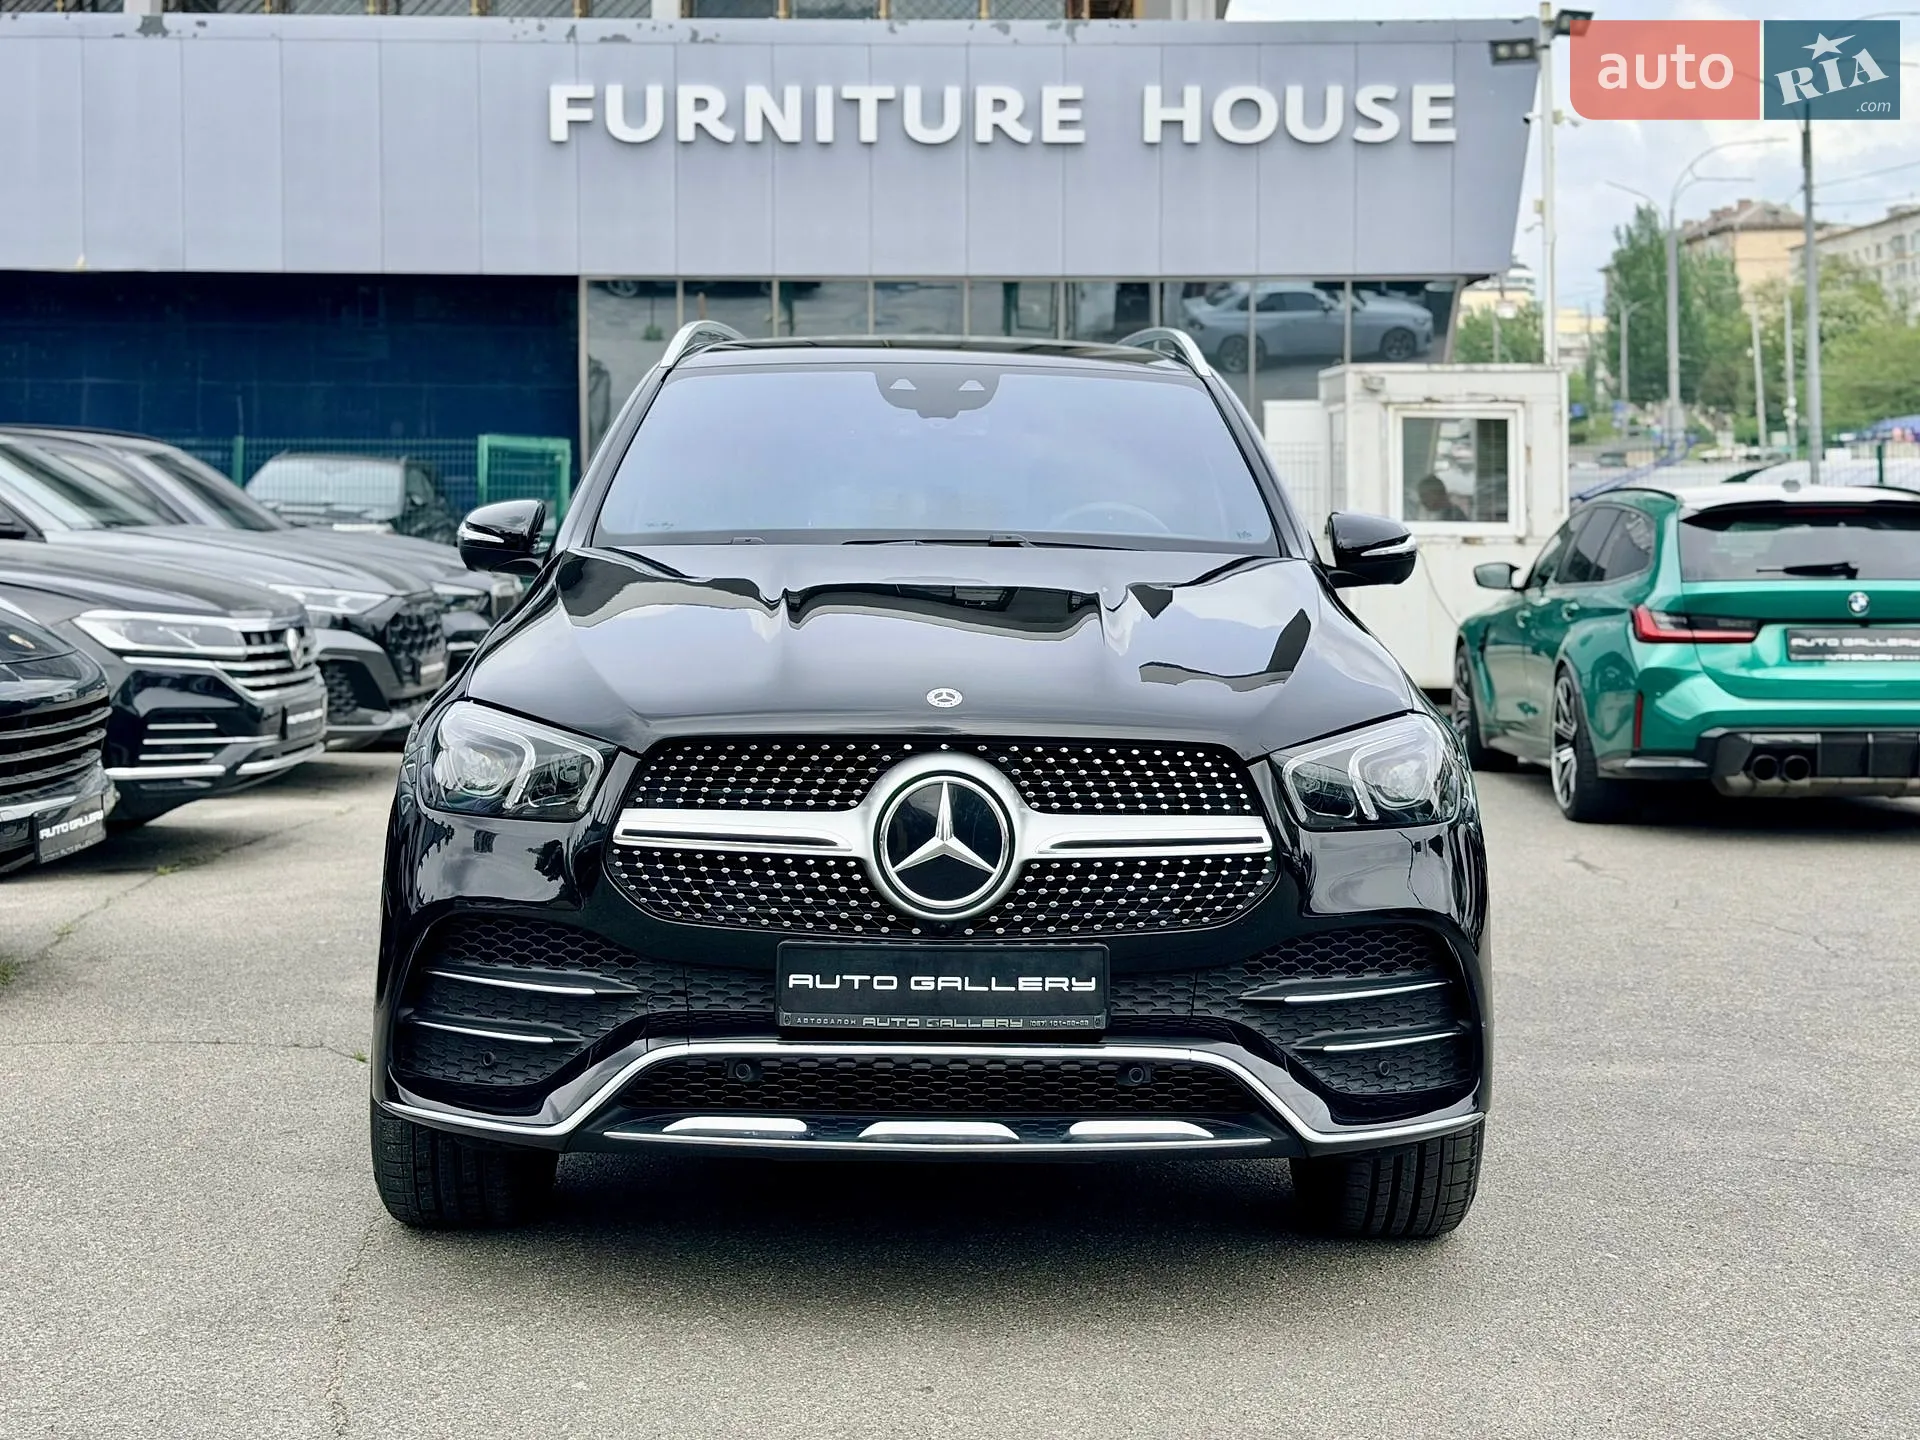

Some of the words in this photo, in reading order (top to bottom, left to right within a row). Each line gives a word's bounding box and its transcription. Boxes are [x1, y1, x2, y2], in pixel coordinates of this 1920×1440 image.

[549, 84, 1086, 145] FURNITURE
[1142, 83, 1457, 145] HOUSE
[39, 823, 69, 840] AUTO
[788, 974, 898, 990] AUTO
[910, 976, 1096, 991] GALLERY
[862, 1017, 920, 1028] AUTO
[926, 1018, 1023, 1029] GALLERY
